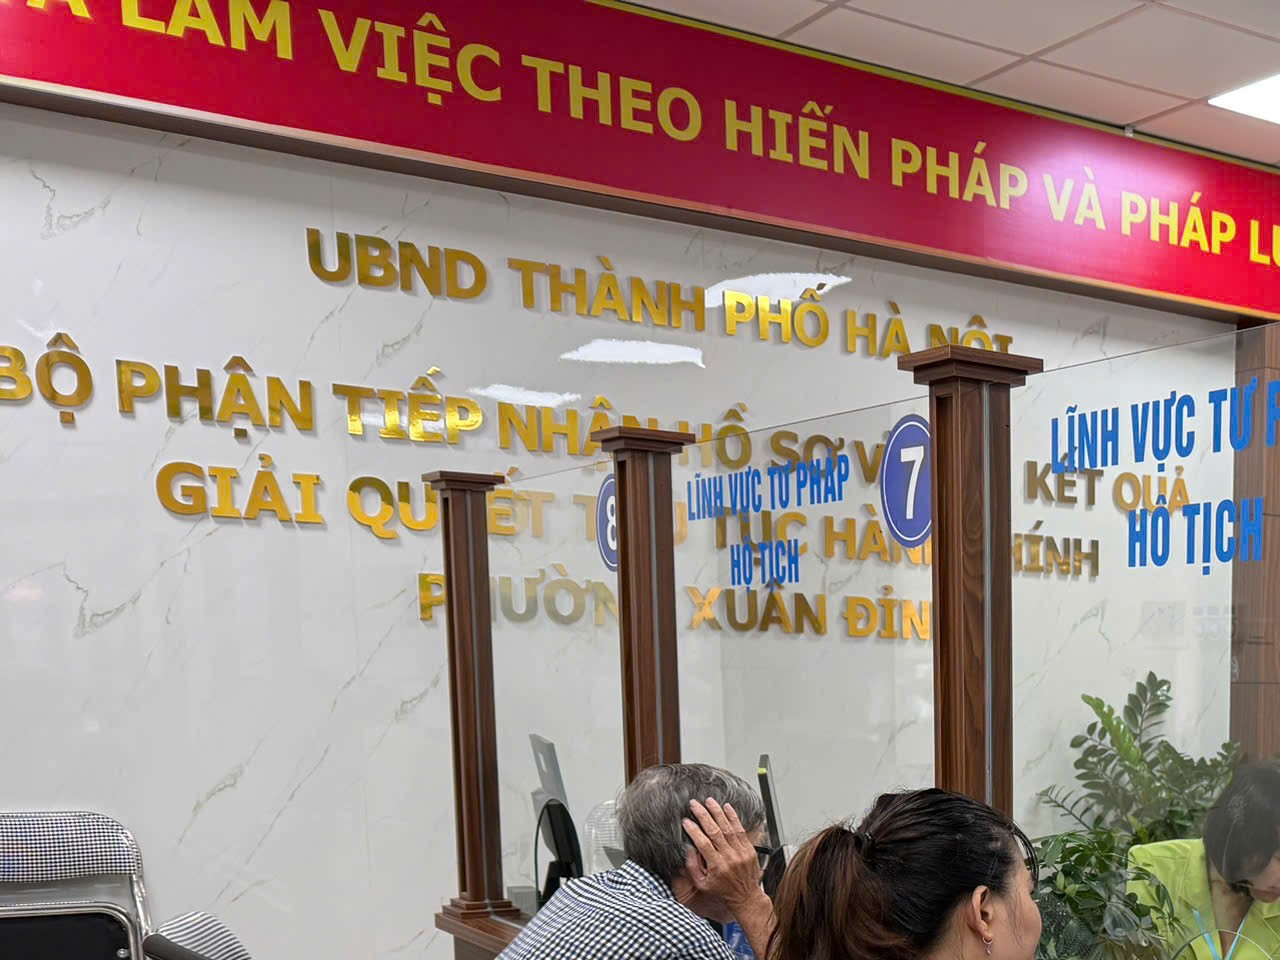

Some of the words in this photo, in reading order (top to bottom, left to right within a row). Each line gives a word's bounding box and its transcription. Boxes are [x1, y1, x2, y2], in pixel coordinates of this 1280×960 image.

[318, 9, 502, 105] VIỆC
[522, 55, 703, 142] THEO
[725, 99, 870, 180] HIẾN
[891, 137, 1029, 212] PHÁP
[1043, 165, 1106, 231] VÀ
[1120, 191, 1237, 255] PHÁP
[306, 227, 487, 300] UBND
[508, 256, 706, 332] THÀNH
[723, 282, 830, 348] PHỐ
[845, 301, 911, 358] HÀ
[0, 333, 94, 424] BỘ
[115, 356, 313, 438] PHẬN
[332, 367, 483, 444] TIẾP
[676, 402, 752, 470] HỒ
[770, 429, 846, 478] SƠ
[854, 432, 890, 484] V
[1025, 447, 1104, 507] KẾT
[1112, 465, 1191, 520] QUẢ
[1051, 403, 1119, 475] LĨNH
[1130, 390, 1196, 472] VỰC
[1208, 375, 1259, 453] TƯ
[155, 453, 325, 525] GIẢI
[347, 466, 555, 540] QUẾT
[1012, 520, 1100, 578] HÍNH
[606, 495, 617, 550] 8
[687, 473, 724, 521] LĨNH
[728, 466, 762, 523] VỰC
[767, 459, 792, 510] TƯ
[796, 447, 850, 506] PHÁP
[899, 445, 925, 520] 7
[758, 539, 799, 592] TỊCH
[1182, 496, 1264, 576] TỊCH
[418, 563, 618, 625] PƯỜN
[687, 577, 827, 635] XUÂN
[842, 585, 932, 640] ĐỈN
